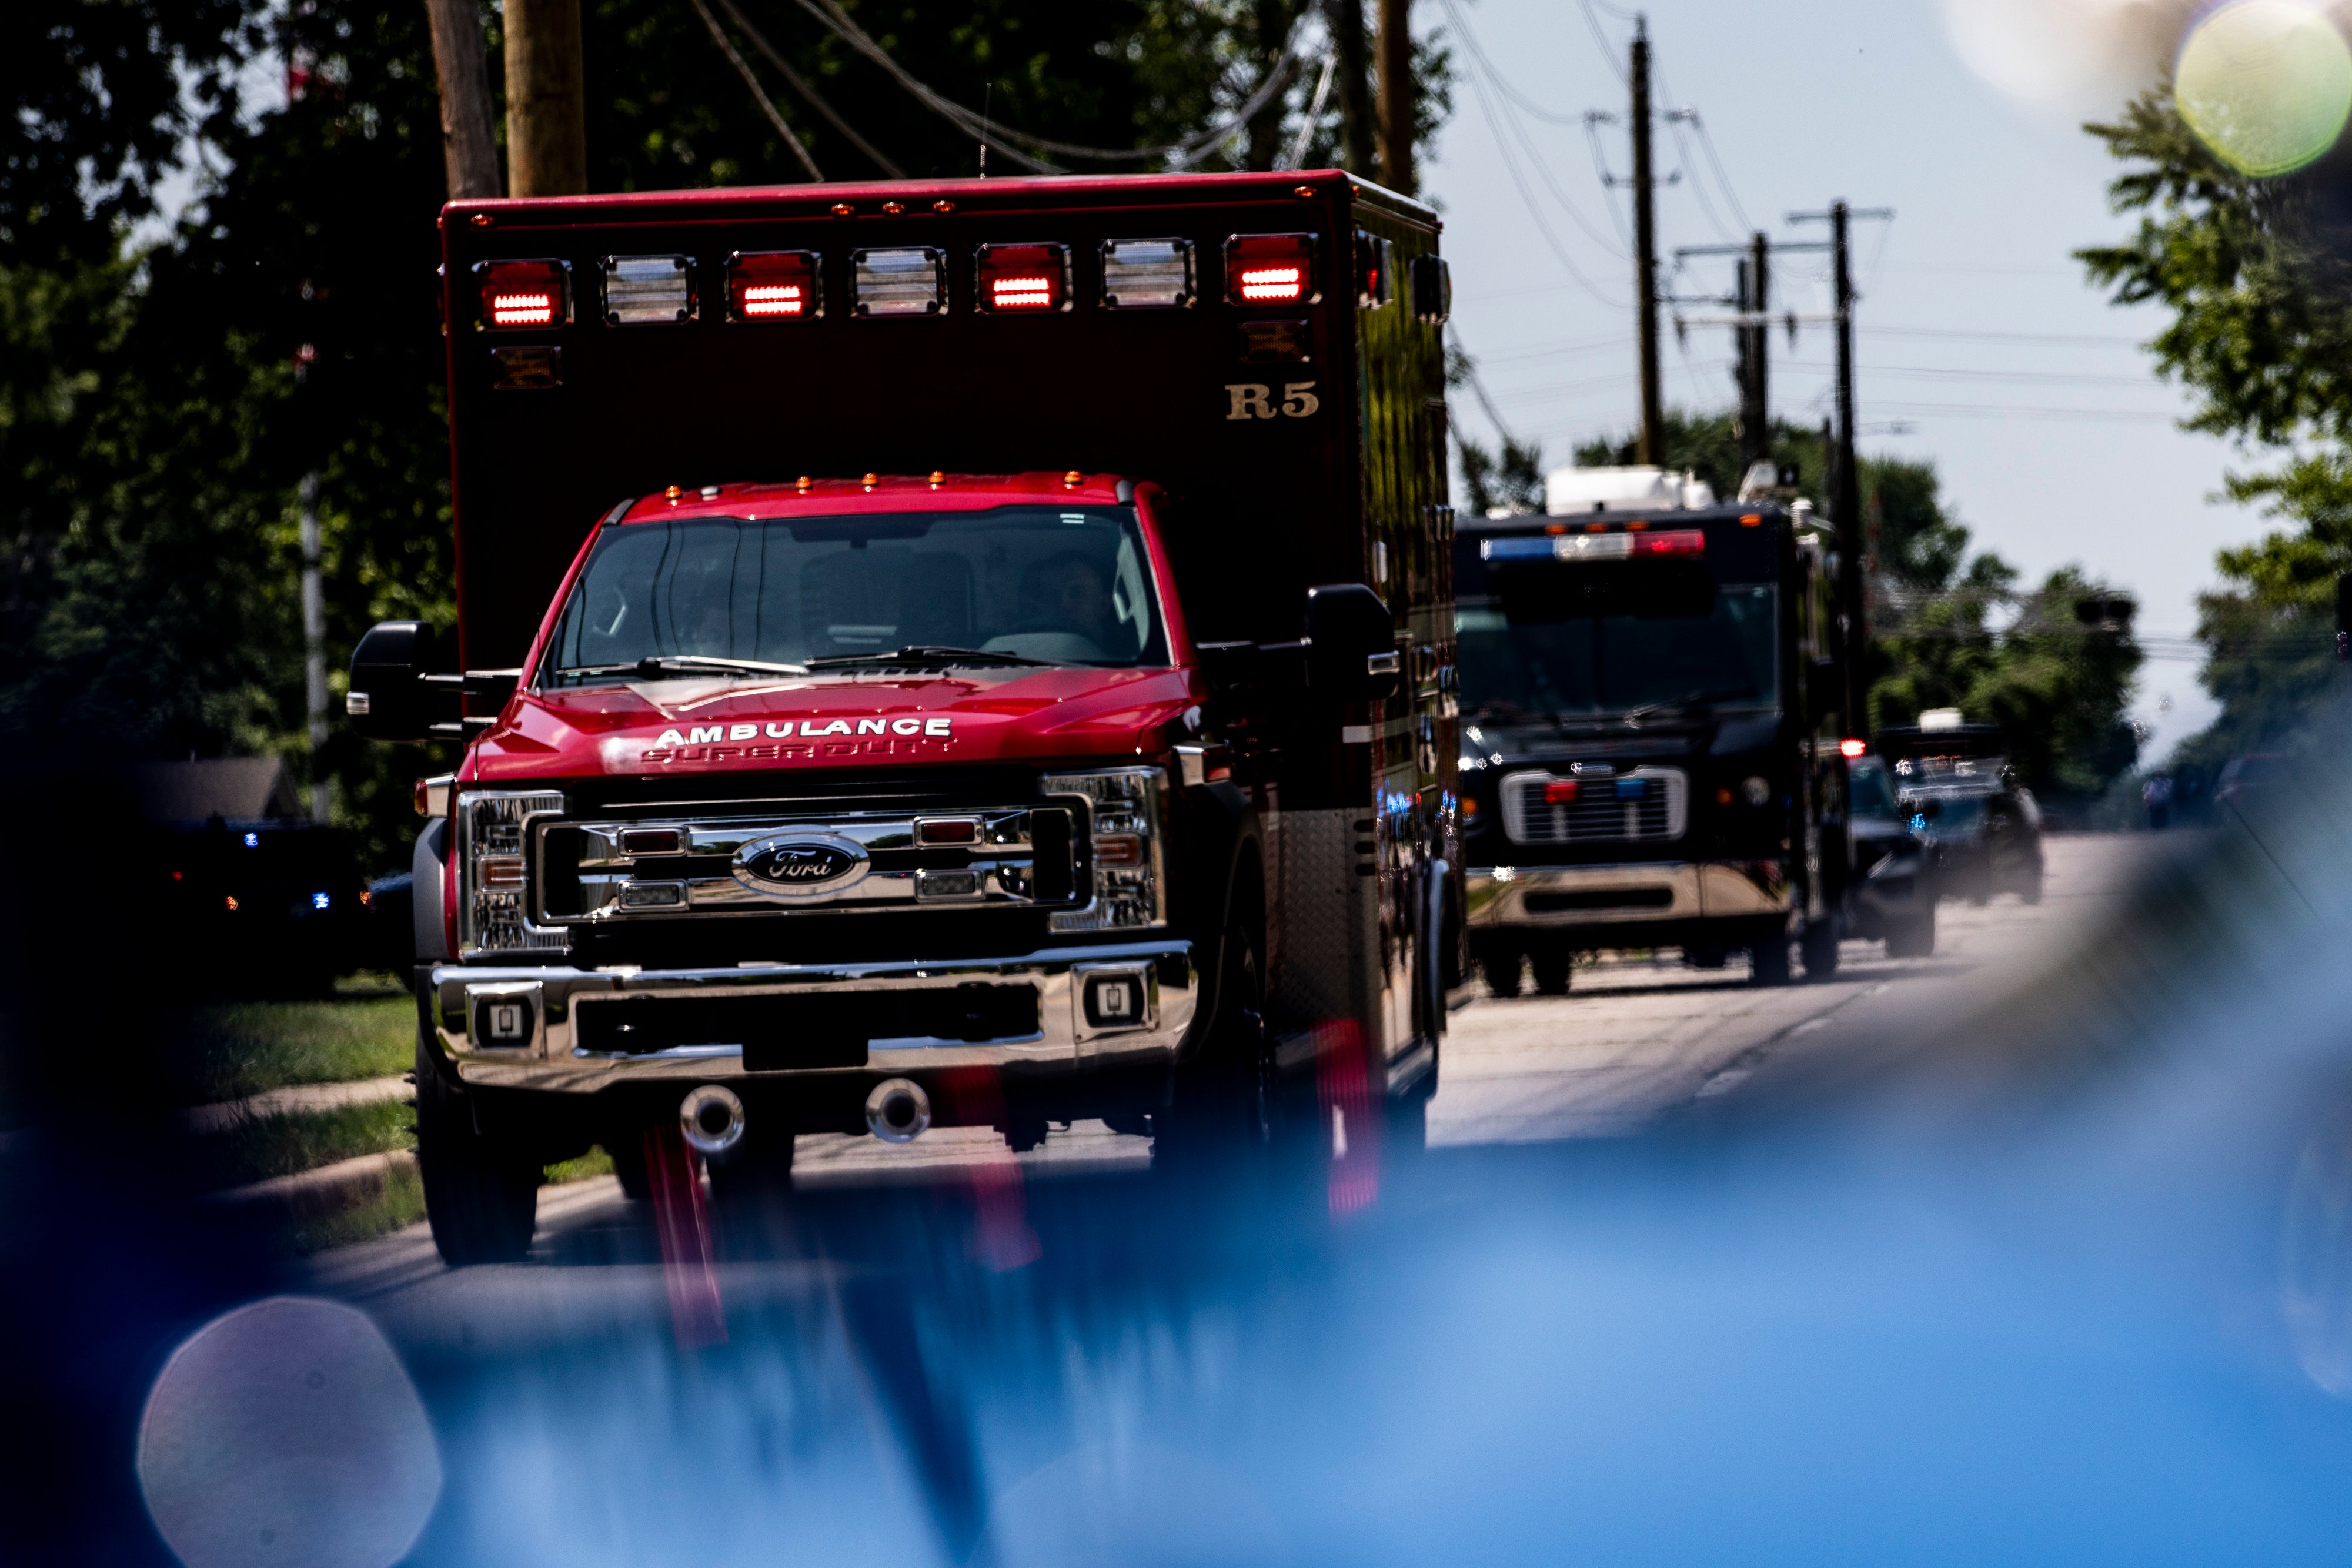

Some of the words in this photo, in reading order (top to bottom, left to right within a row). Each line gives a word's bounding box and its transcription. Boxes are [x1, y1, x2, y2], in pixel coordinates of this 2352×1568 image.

[1224, 380, 1319, 420] R5
[653, 718, 953, 749] AMBULANCE
[641, 743, 814, 763] SUPER
[824, 737, 958, 757] DUTY
[769, 850, 833, 877] Ford
